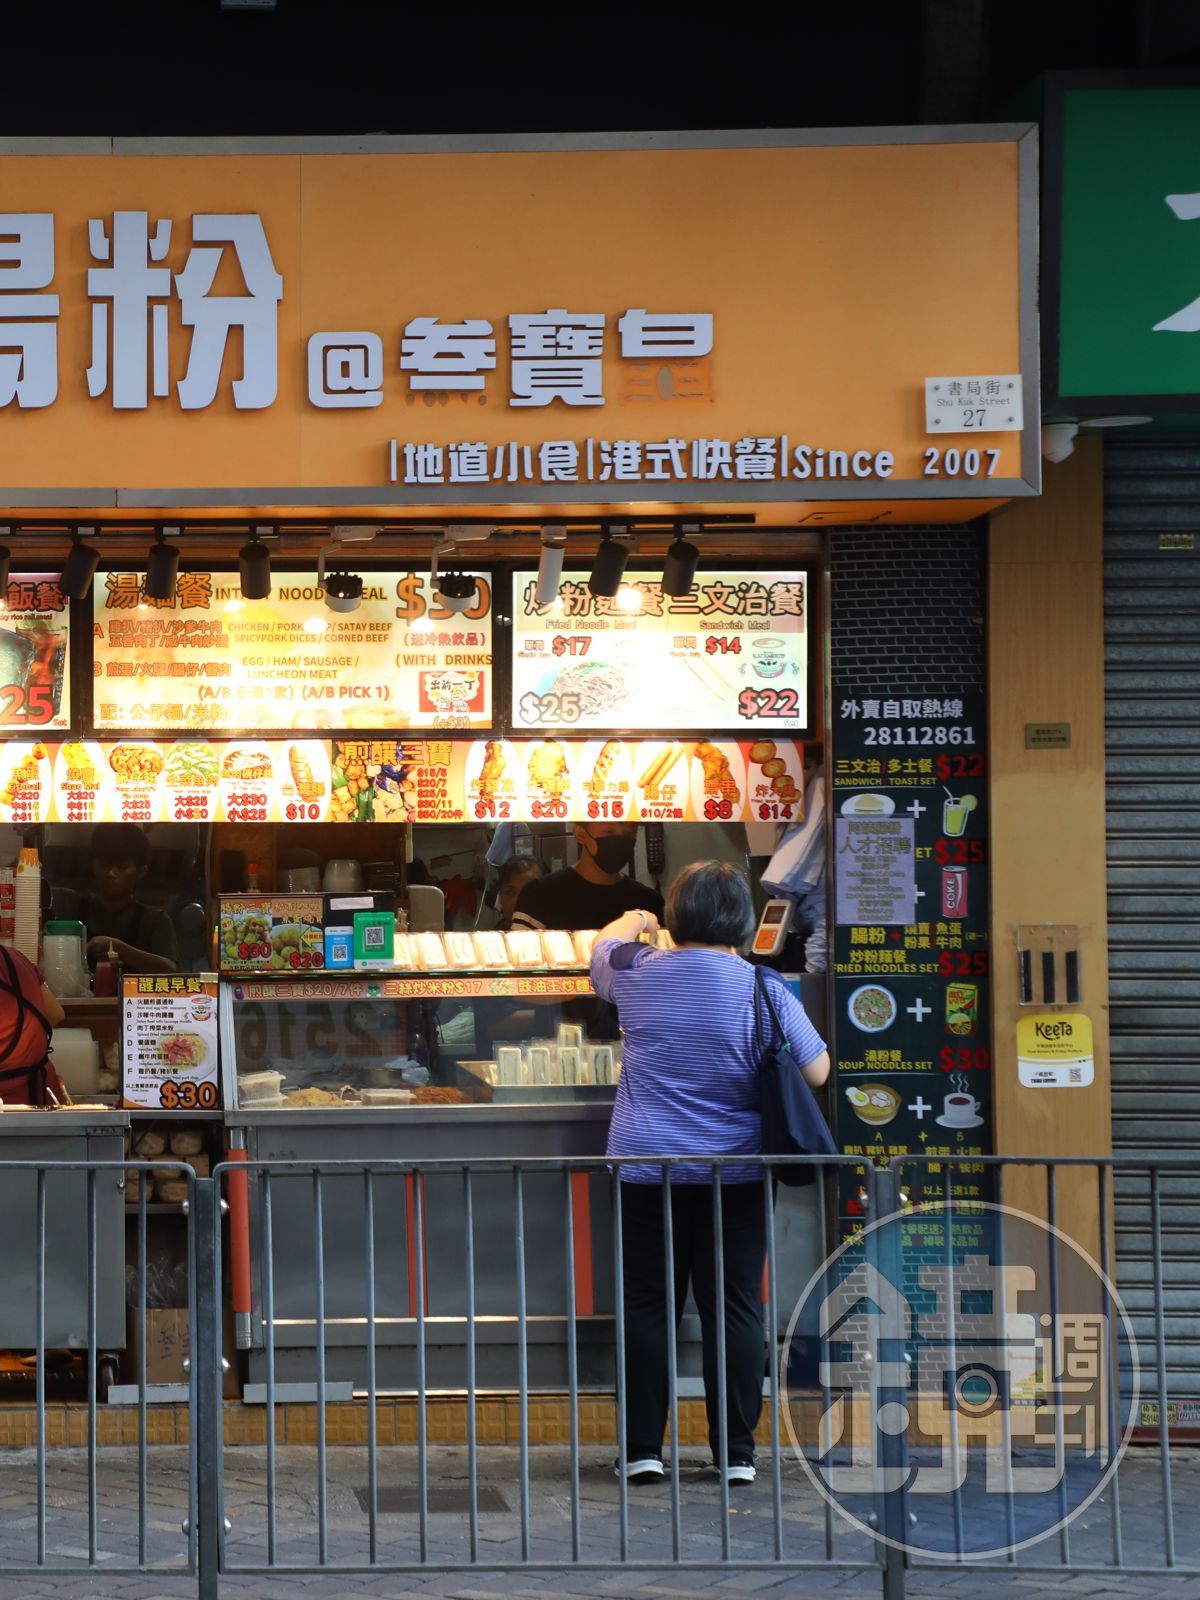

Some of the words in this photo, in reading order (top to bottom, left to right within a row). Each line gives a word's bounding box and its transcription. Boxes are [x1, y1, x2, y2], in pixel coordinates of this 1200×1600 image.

[948, 380, 1001, 396] 書局街
[937, 398, 953, 407] Shu
[958, 398, 974, 406] Kuk
[979, 397, 1011, 406] Street
[963, 409, 987, 427] 27
[924, 447, 1002, 476] 2007
[228, 622, 270, 632] CHICKEN
[337, 622, 368, 632] SATAY
[370, 622, 393, 632] BEEF
[545, 619, 571, 629] Fried
[699, 620, 745, 630] Sandwich
[748, 620, 771, 630] Meal
[289, 633, 318, 643] DICES
[324, 633, 364, 643] CORNED
[366, 633, 389, 643] BEEF
[551, 635, 592, 657] $17
[705, 635, 742, 656] $14
[242, 656, 264, 666] EGG
[303, 656, 353, 666] SAUSAGE
[445, 654, 492, 666] DRINKS
[247, 669, 307, 679] LUNCHEON
[309, 669, 339, 679] MEAT
[302, 685, 336, 700] (A/B
[339, 686, 372, 698] PICK
[429, 679, 476, 692] 出前一丁
[519, 691, 582, 725] $25
[738, 687, 799, 721] $22
[840, 699, 964, 720] 外賣自取熱線
[863, 726, 976, 746] 28112861
[935, 753, 985, 780] $22
[834, 777, 882, 786] SANDWICH
[889, 777, 919, 786] TOAST
[919, 777, 937, 786] SET
[643, 784, 677, 800] 腸仔
[285, 803, 321, 821] $10
[474, 800, 511, 819] $12
[530, 800, 568, 819] $20
[587, 801, 625, 819] $15
[703, 798, 733, 820] $8
[758, 803, 793, 821] $14
[838, 836, 912, 855] 人才招聘
[933, 836, 986, 866] $25
[945, 877, 956, 909] COKE
[850, 927, 887, 945] 腸粉
[238, 943, 272, 960] $30
[289, 951, 324, 968] $20
[849, 949, 907, 963] 炒粉麵餐
[938, 951, 988, 977] $25
[864, 963, 917, 973] NOODLES
[919, 963, 940, 973] SET
[138, 977, 202, 993] 醒晨早餐
[127, 1039, 133, 1047] D
[127, 1053, 134, 1061] E
[837, 1061, 865, 1070] SOUP
[866, 1061, 914, 1070] NOODLES
[915, 1061, 934, 1070] SET
[938, 1045, 988, 1073] $30
[159, 1080, 218, 1109] $30
